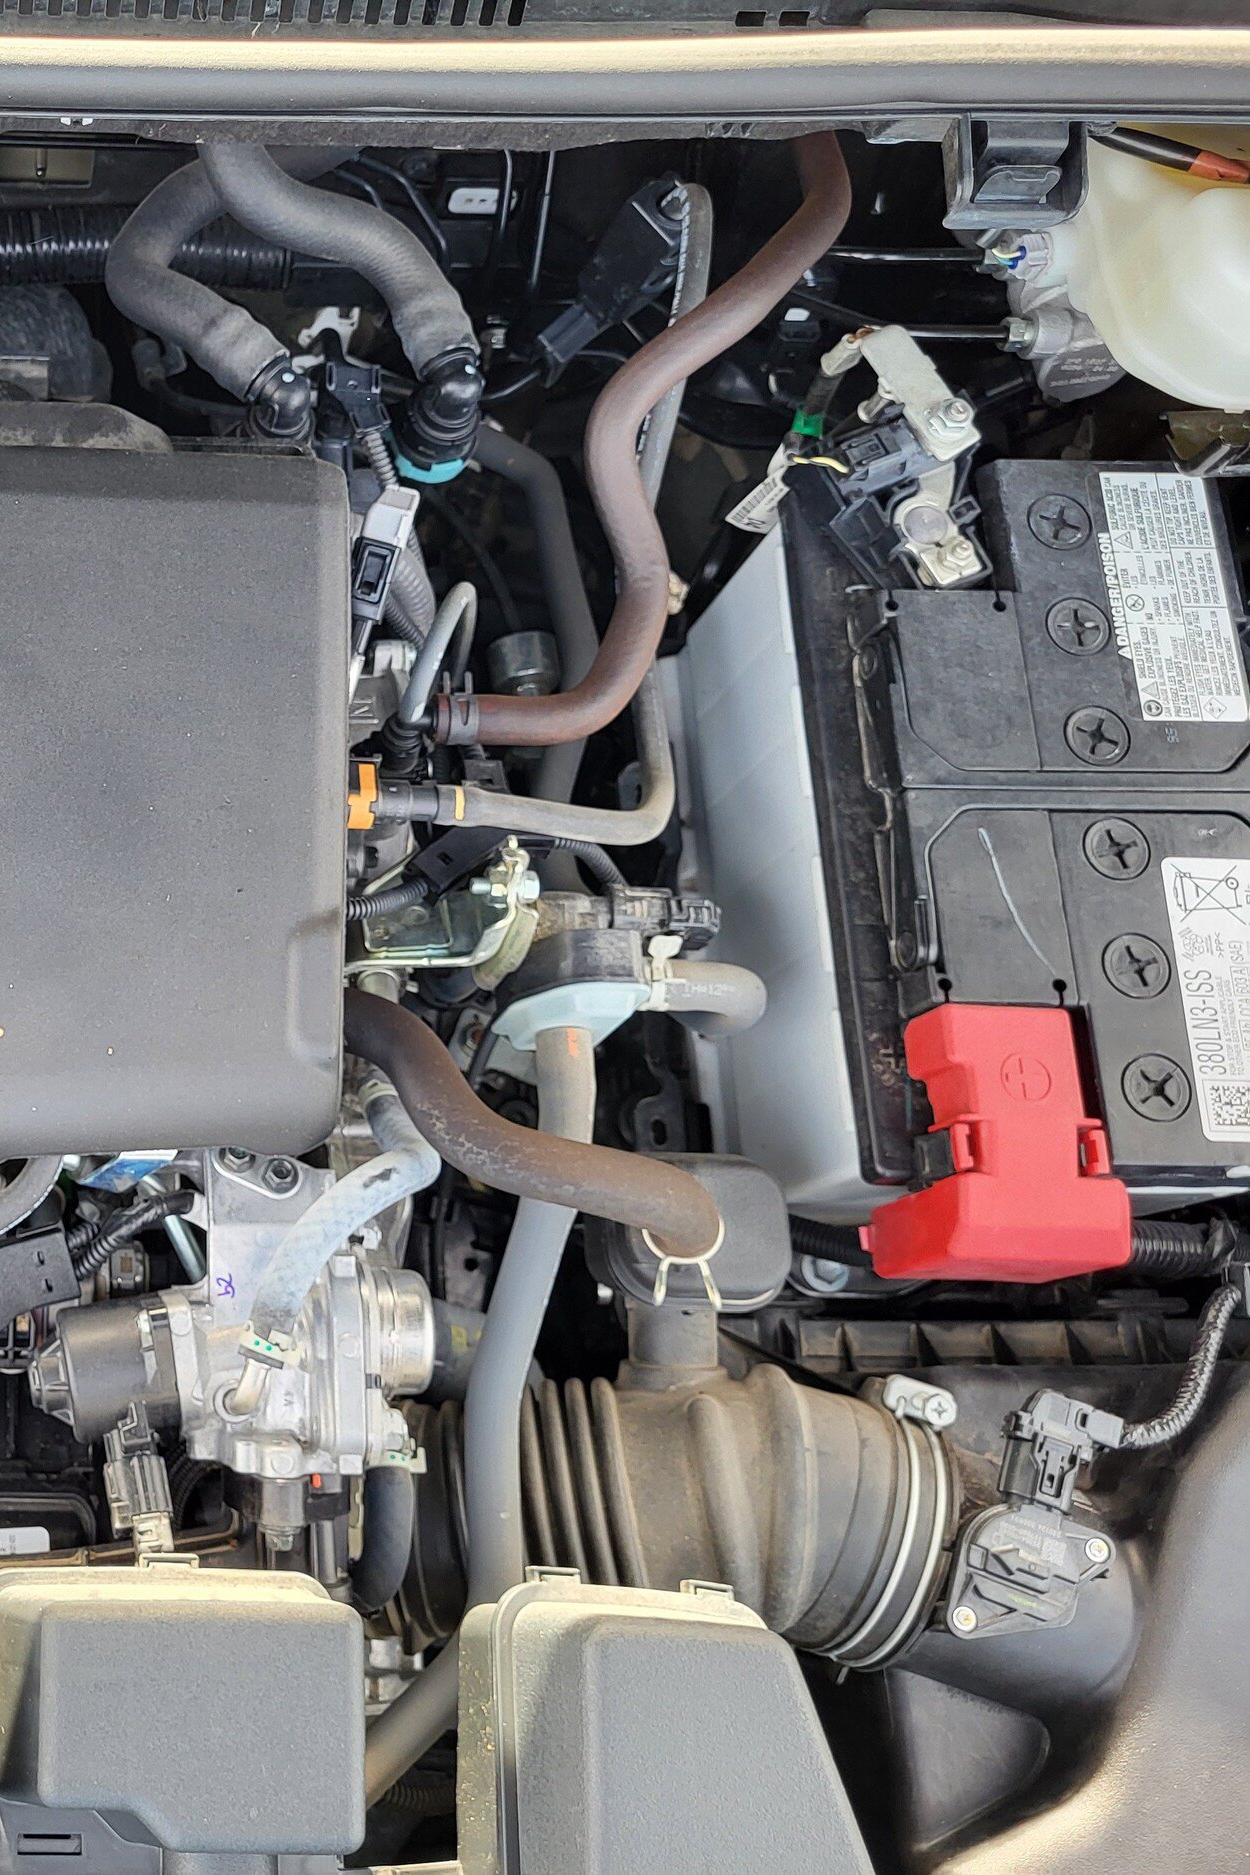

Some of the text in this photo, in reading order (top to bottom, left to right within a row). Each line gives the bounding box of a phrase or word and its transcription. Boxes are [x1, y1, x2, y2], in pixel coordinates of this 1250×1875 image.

[1103, 477, 1111, 486] CAN
[1112, 485, 1124, 512] BLINDNESS
[1129, 487, 1144, 524] SULFURIQUE
[1106, 503, 1119, 529] SULFURIC
[1097, 531, 1129, 644] DANGER/POISON
[1213, 975, 1227, 1013] APPLICABLE
[1222, 979, 1232, 996] CARS
[1183, 970, 1227, 1074] 380LN3-ISS
[1220, 1015, 1231, 1035] START
[1225, 998, 1237, 1026] FRIENDLY
[1224, 1044, 1235, 1061] STOP
[1232, 1044, 1243, 1065] OTHER
[1228, 1062, 1237, 1075] FOR
